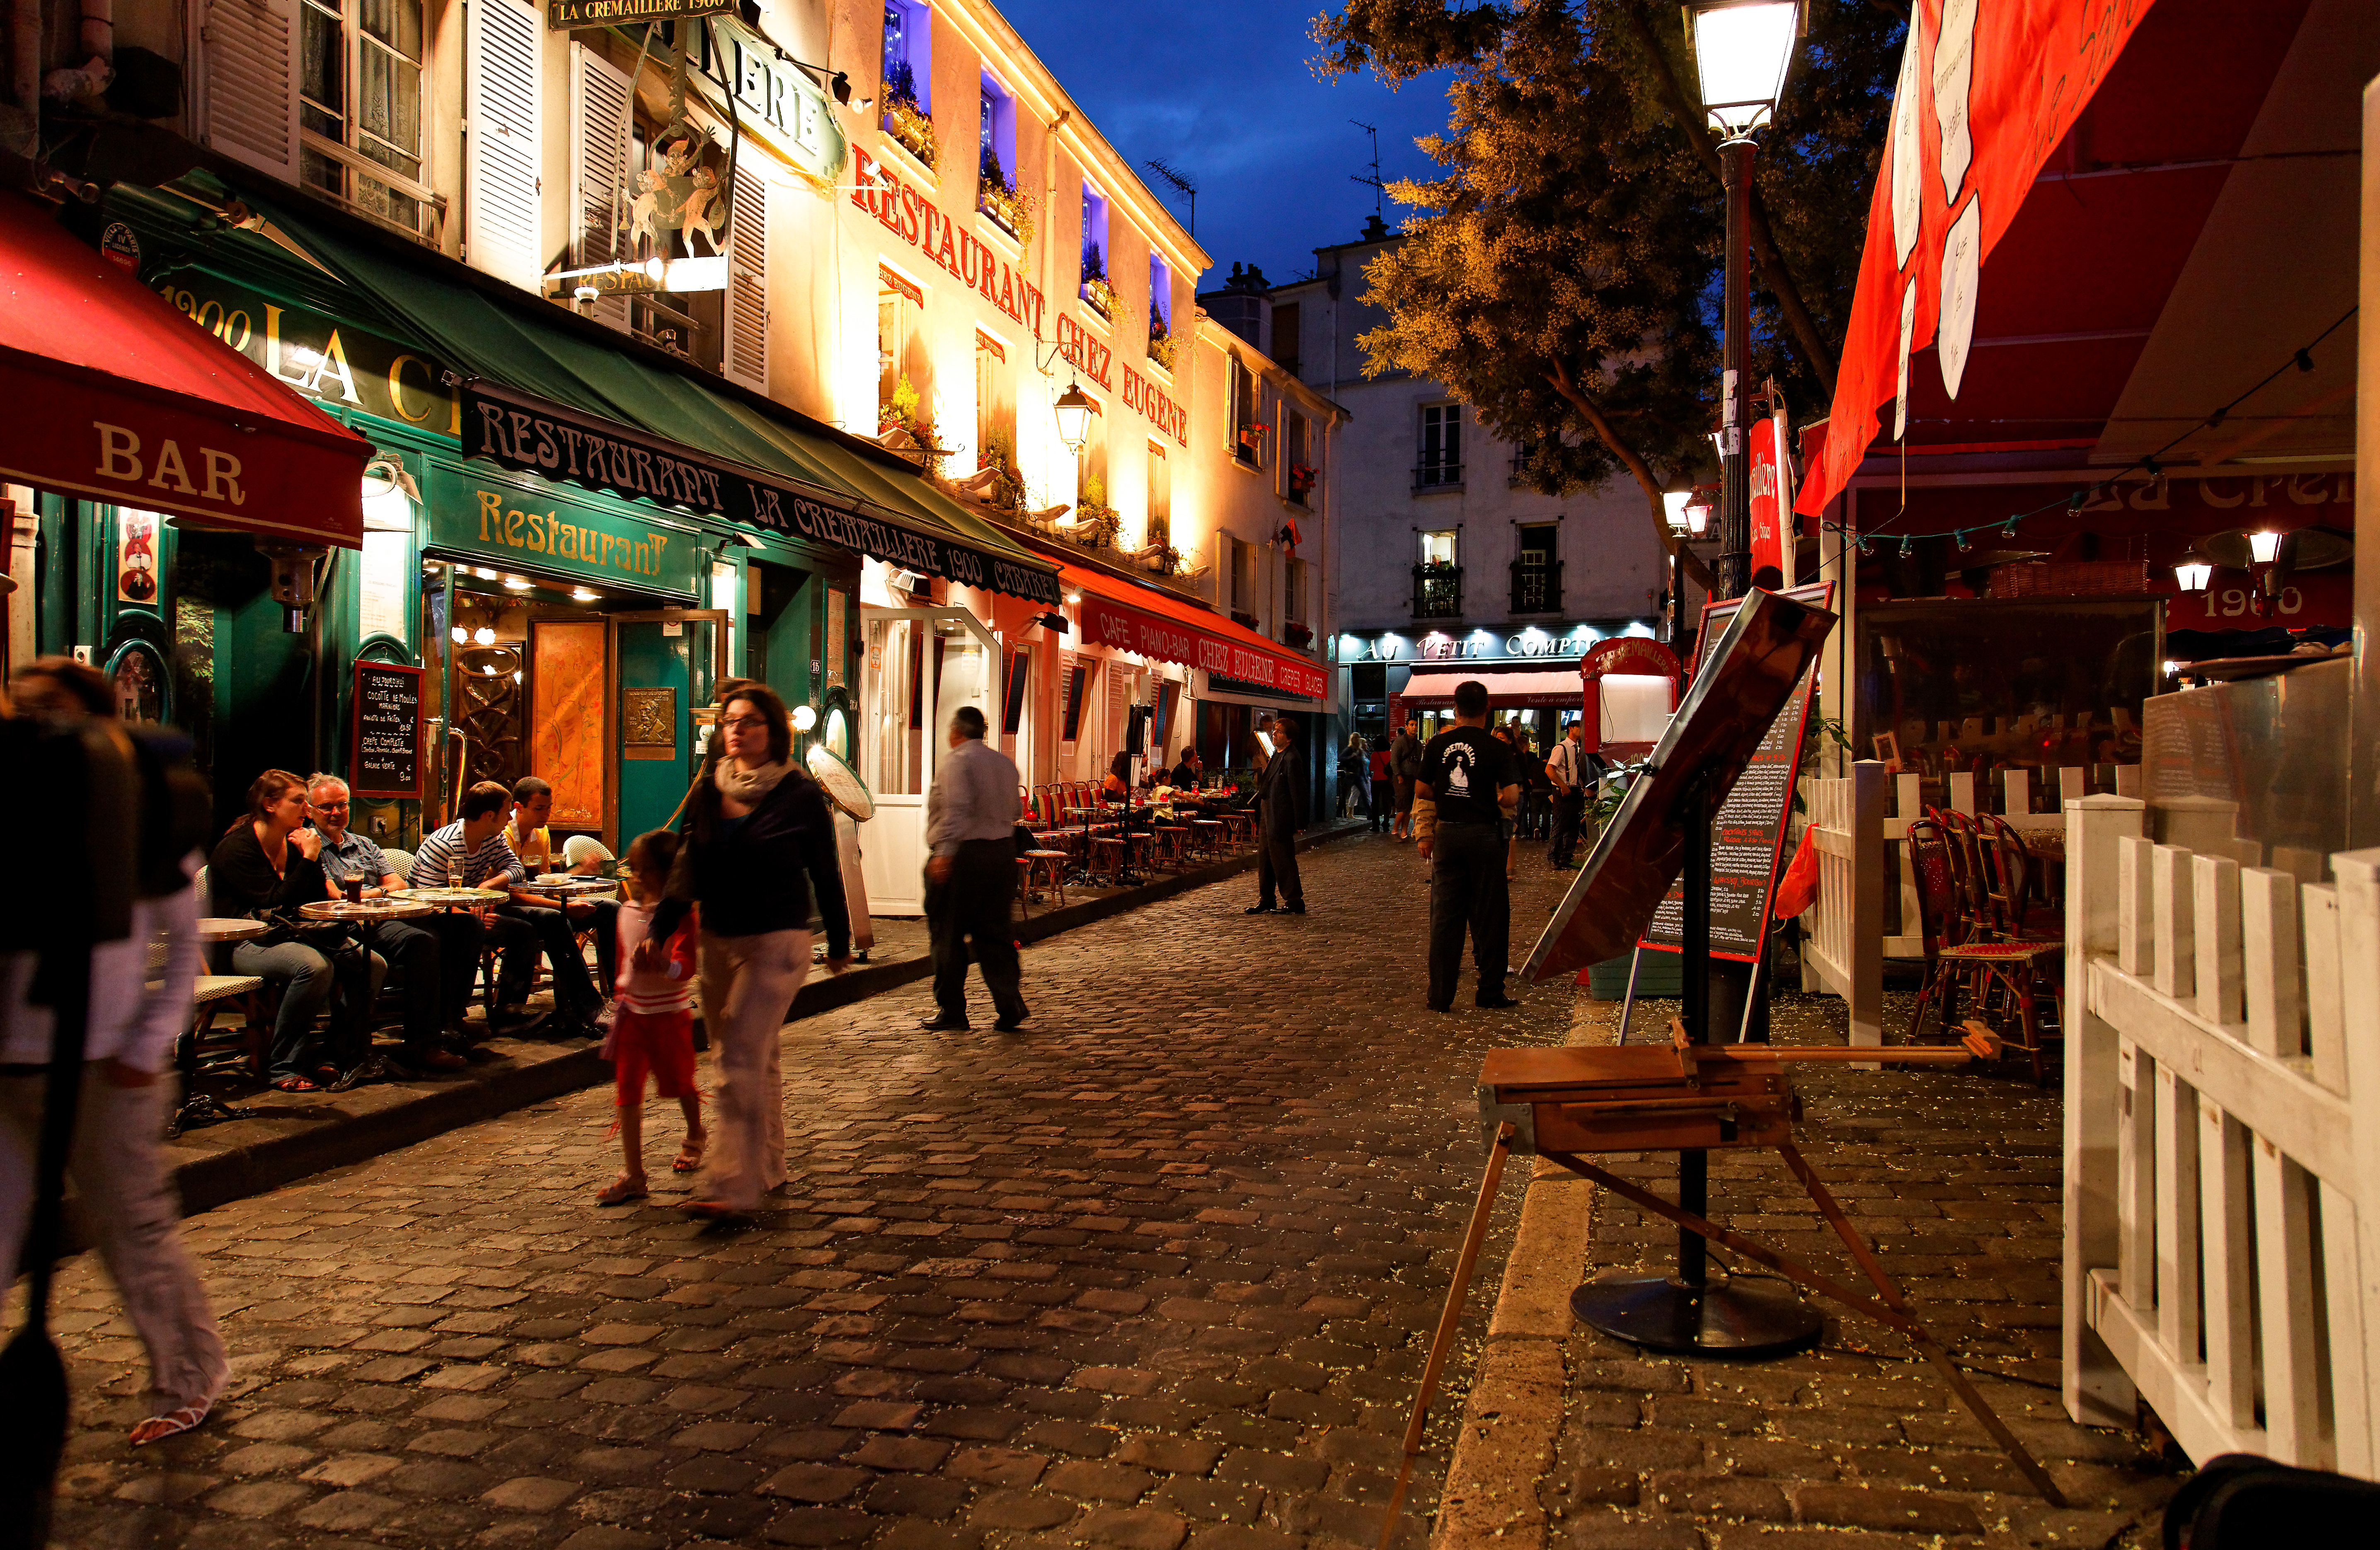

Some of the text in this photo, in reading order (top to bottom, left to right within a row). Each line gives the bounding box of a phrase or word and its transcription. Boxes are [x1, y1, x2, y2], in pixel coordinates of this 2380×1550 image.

[559, 4, 579, 20] LA
[851, 143, 1046, 339] RESTAURANT
[1057, 312, 1111, 392] CHEZ
[879, 268, 892, 285] HEZ
[262, 302, 364, 406] LA
[93, 421, 245, 505] BAR
[477, 401, 1058, 601] RESTAURANT LA CREMAILLERE 1900 CABARET
[1100, 613, 1131, 644] CAFE
[1140, 625, 1190, 660] PIANO-BAR
[1198, 638, 1228, 672] CHEZ
[1235, 649, 1274, 684] EUGENE
[1280, 666, 1300, 688] CREPES
[1305, 674, 1323, 694] GLACES
[1506, 634, 1624, 655] COMPTO
[811, 662, 820, 672] 15
[367, 690, 389, 701] COCOTTE
[1556, 695, 1584, 705] emport
